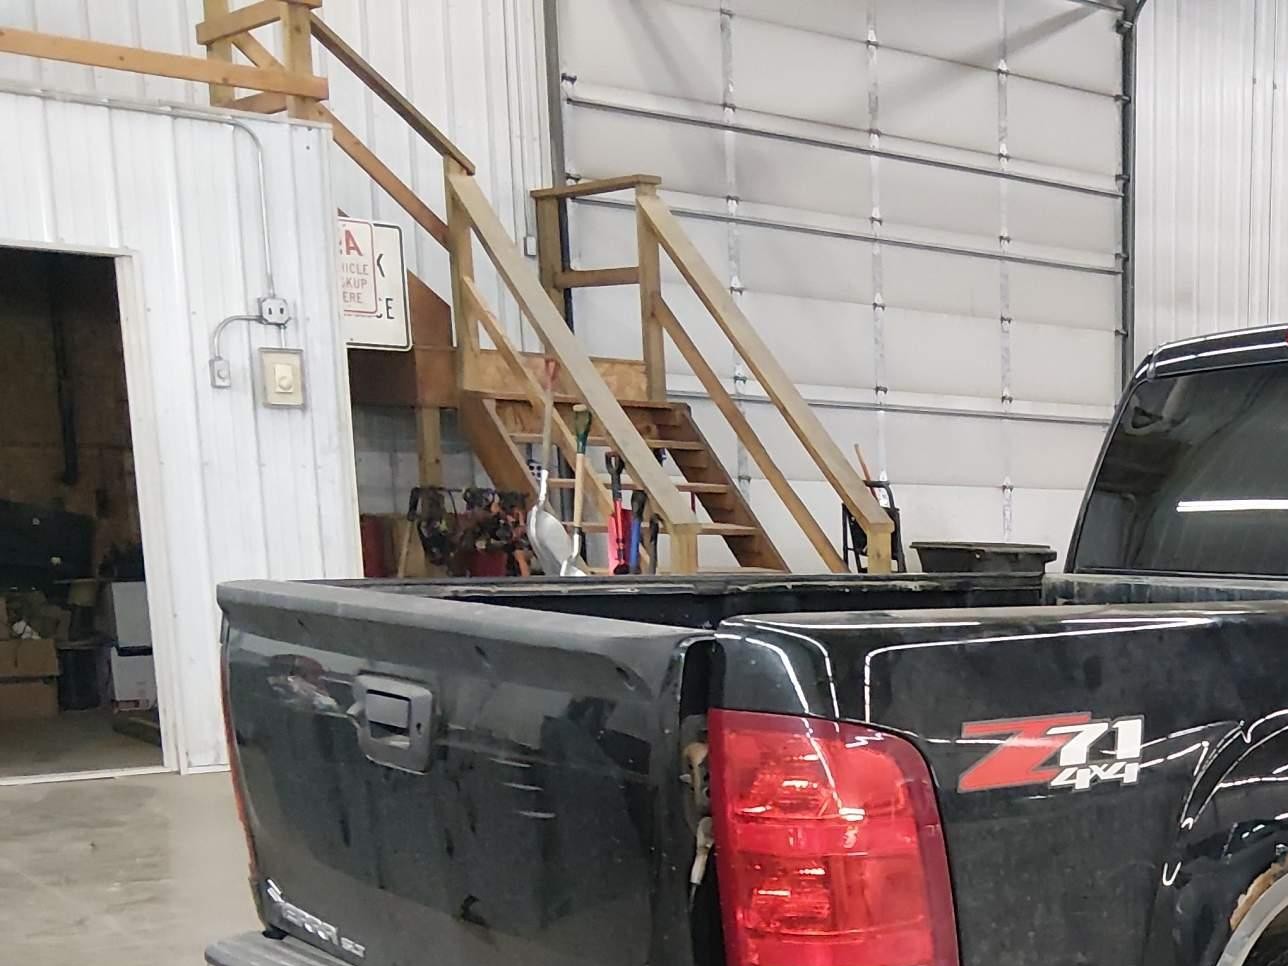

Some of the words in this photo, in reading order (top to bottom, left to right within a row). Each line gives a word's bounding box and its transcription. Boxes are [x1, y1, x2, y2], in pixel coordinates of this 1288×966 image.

[342, 263, 369, 276] ICLE
[342, 278, 368, 290] KUP
[957, 711, 1145, 794] Z71
